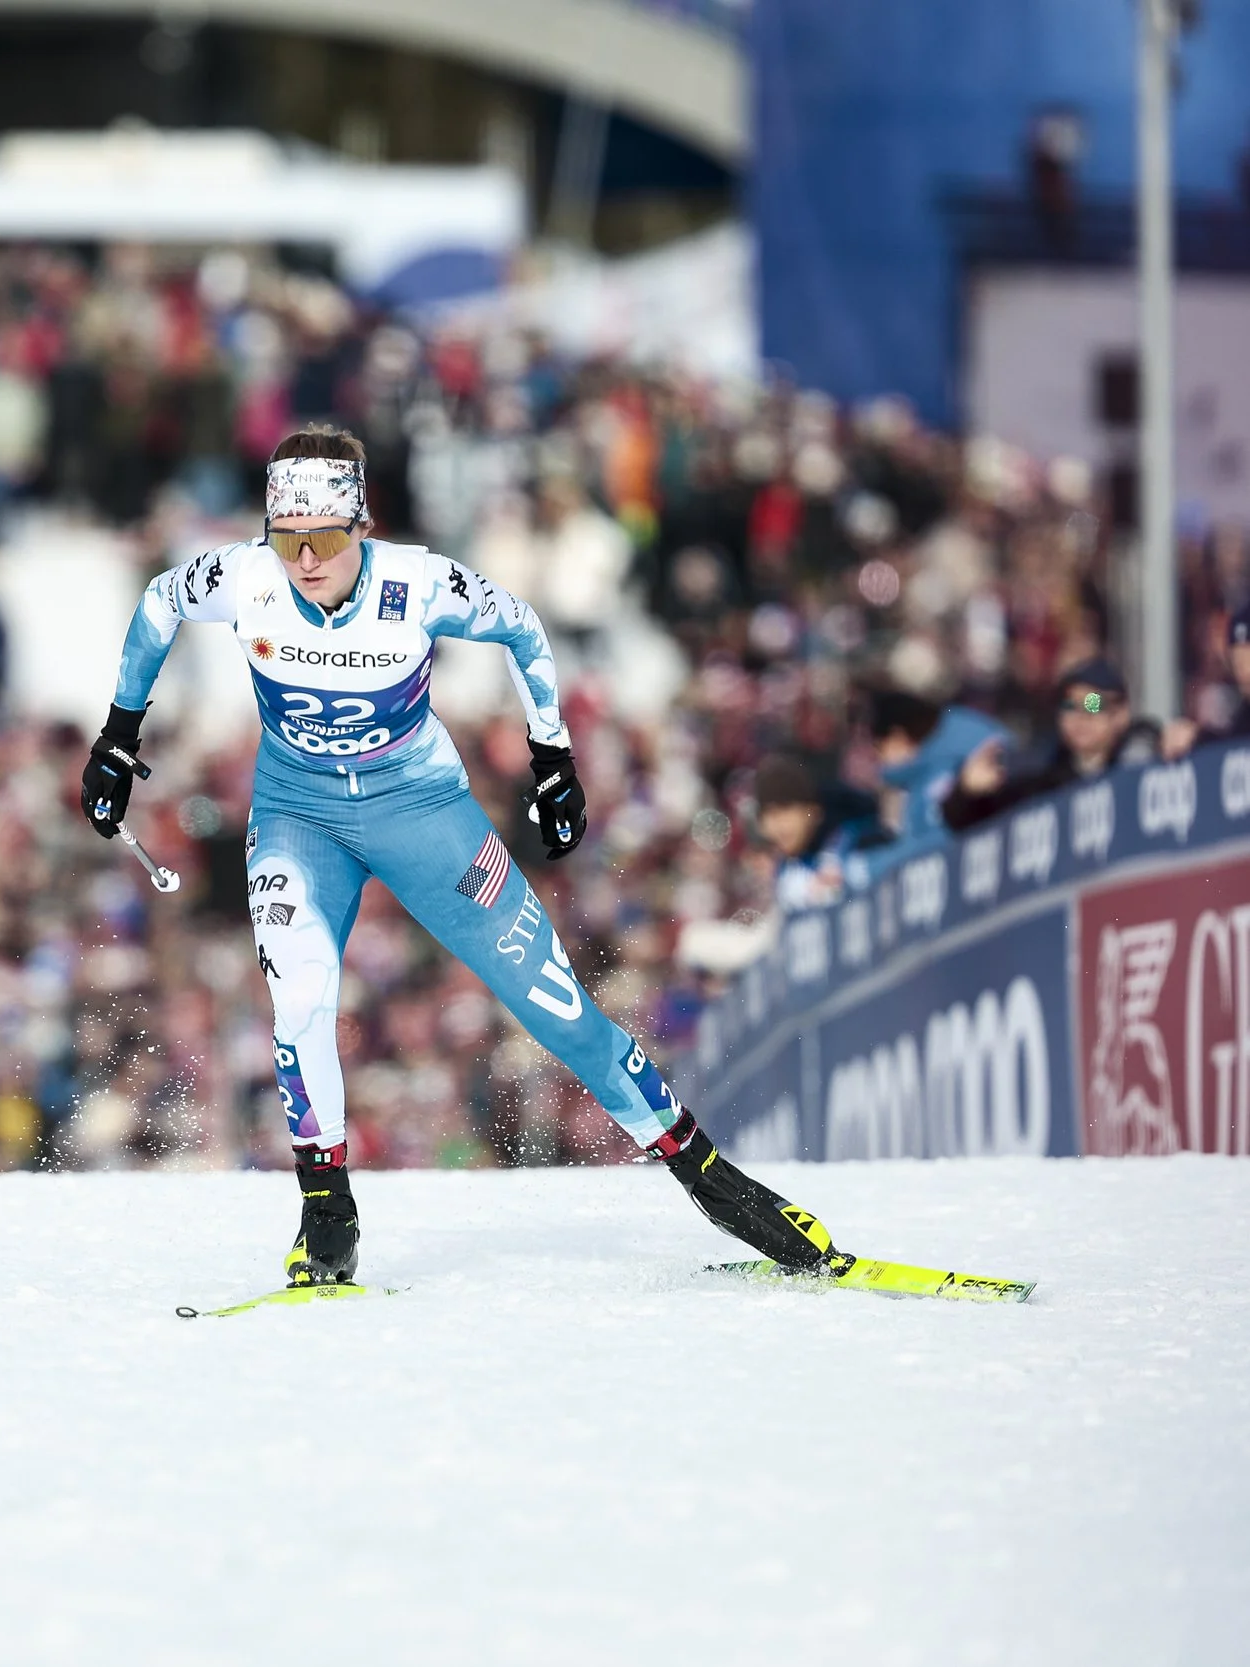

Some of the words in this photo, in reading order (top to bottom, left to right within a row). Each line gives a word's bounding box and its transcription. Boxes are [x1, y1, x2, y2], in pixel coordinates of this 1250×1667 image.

[295, 490, 309, 498] US
[279, 646, 407, 668] StoraEnso
[281, 692, 376, 726] 22
[316, 1287, 338, 1297] FISCHER
